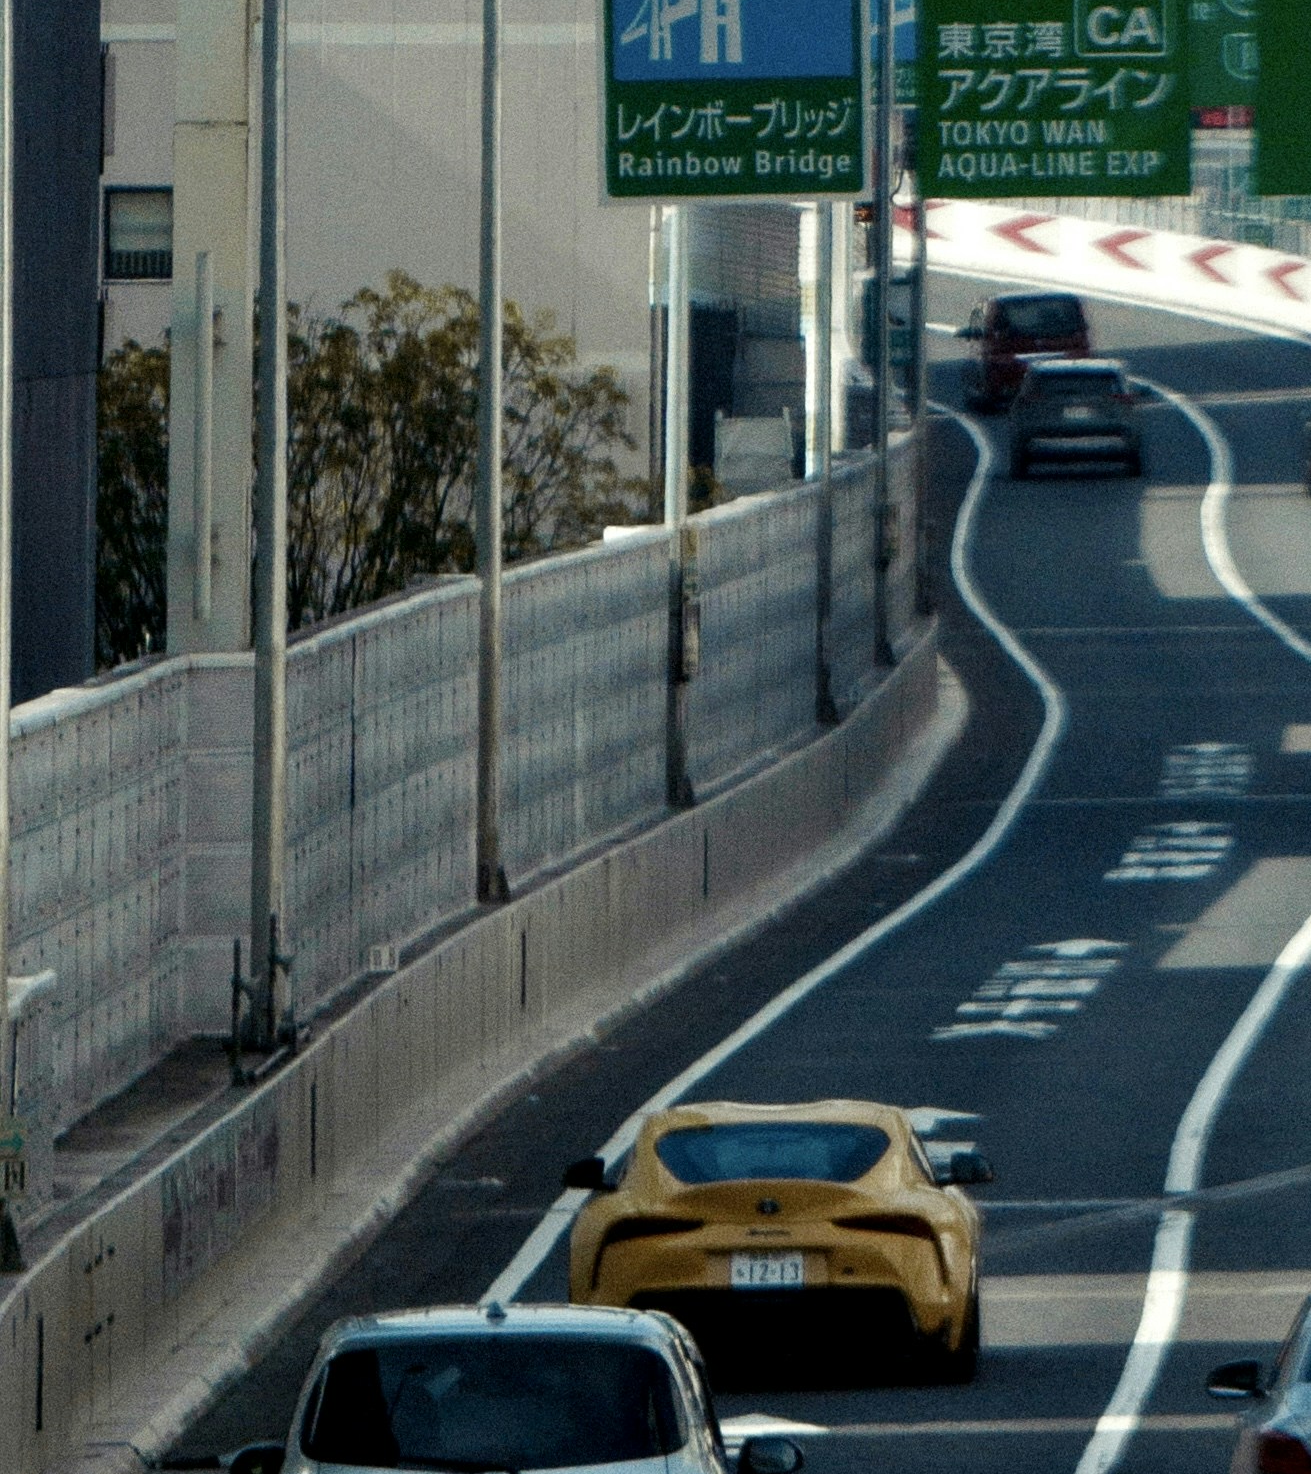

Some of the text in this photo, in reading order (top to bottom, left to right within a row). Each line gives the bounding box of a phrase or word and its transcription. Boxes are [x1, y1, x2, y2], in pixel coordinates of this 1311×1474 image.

[938, 22, 1063, 58] 東京湾
[1086, 5, 1161, 46] CA
[937, 69, 1172, 112] アクアライン
[617, 97, 853, 143] レインボーブリッジ
[938, 119, 1106, 144] TOKYO WAN
[618, 150, 851, 184] Rainbow Bridge
[938, 151, 1161, 181] AQUA-LINE EXP
